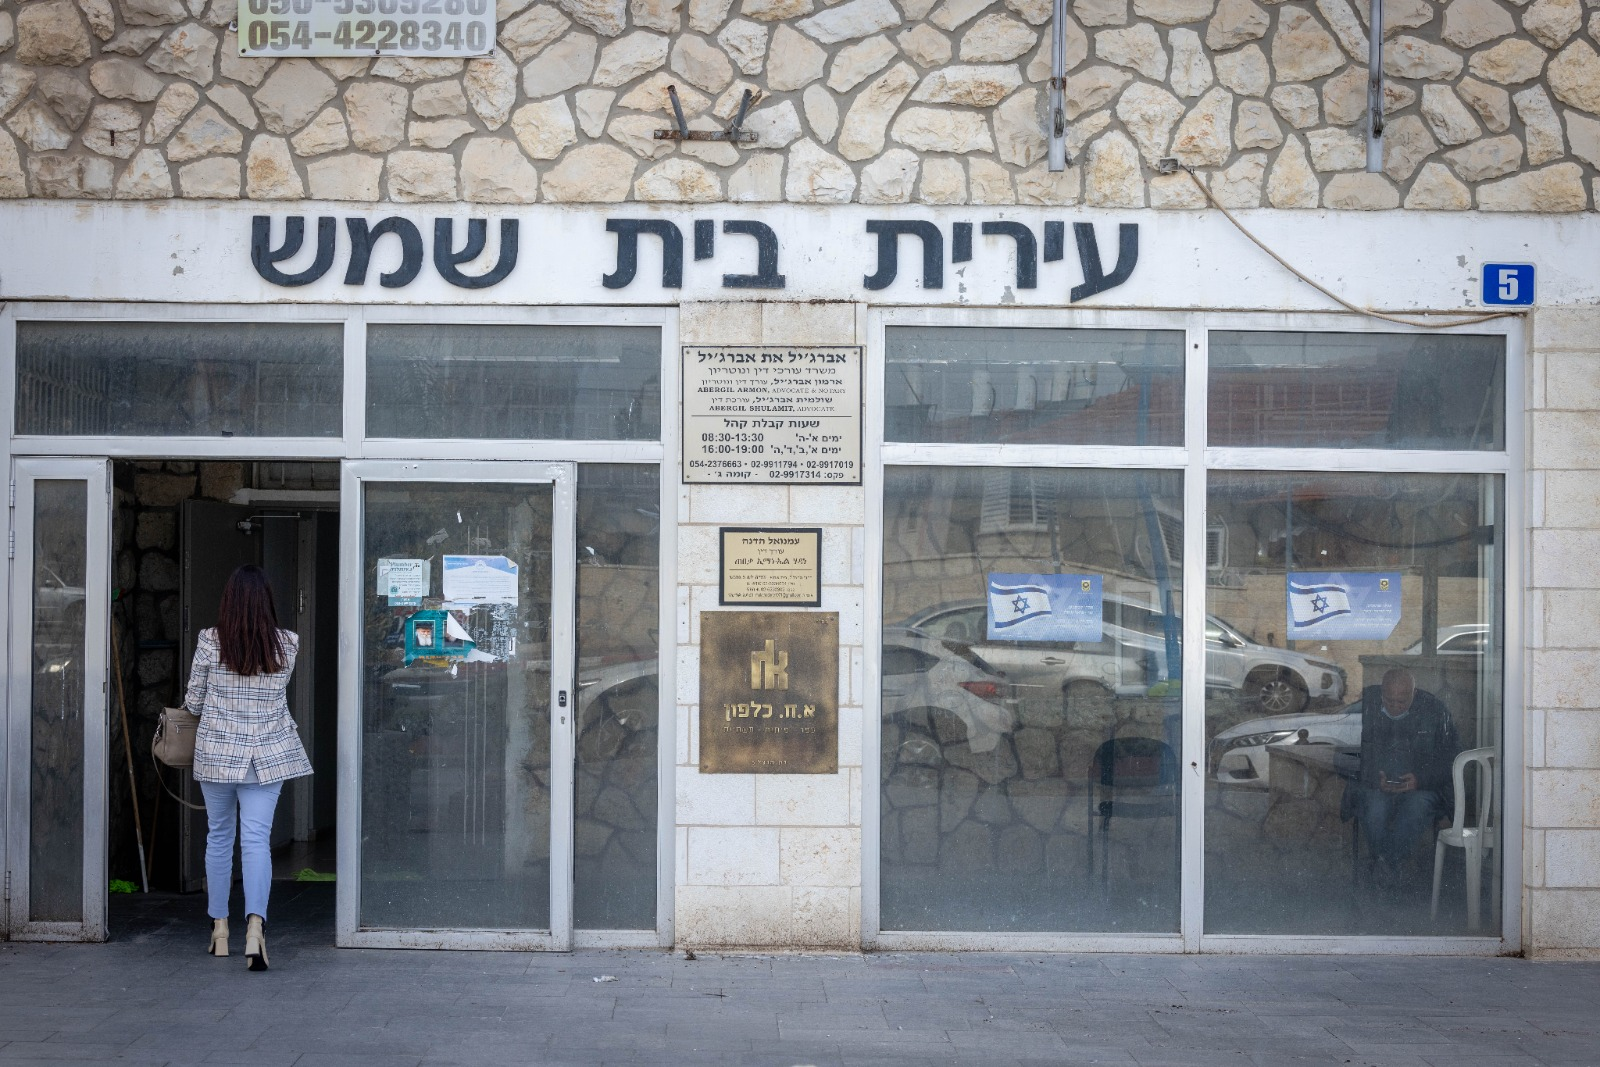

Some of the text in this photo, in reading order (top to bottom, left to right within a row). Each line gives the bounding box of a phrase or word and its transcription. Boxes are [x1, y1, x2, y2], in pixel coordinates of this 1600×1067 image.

[248, 20, 487, 51] 054-4228340
[251, 216, 1138, 304] עירית בית שמש
[1498, 269, 1519, 301] 5
[697, 350, 847, 363] אברג'יל את אברג'יל
[754, 367, 769, 376] דין
[773, 367, 802, 375] עורכי
[804, 367, 836, 375] משרד
[749, 405, 796, 413] SHULAMIT,
[723, 418, 820, 429] שעות קבלת קהל
[701, 433, 764, 442] 08:30-13:30
[701, 445, 764, 454] 16:00-19:00
[726, 471, 751, 479] קומה
[824, 472, 844, 480] פקס:
[723, 701, 773, 722] כלפון
